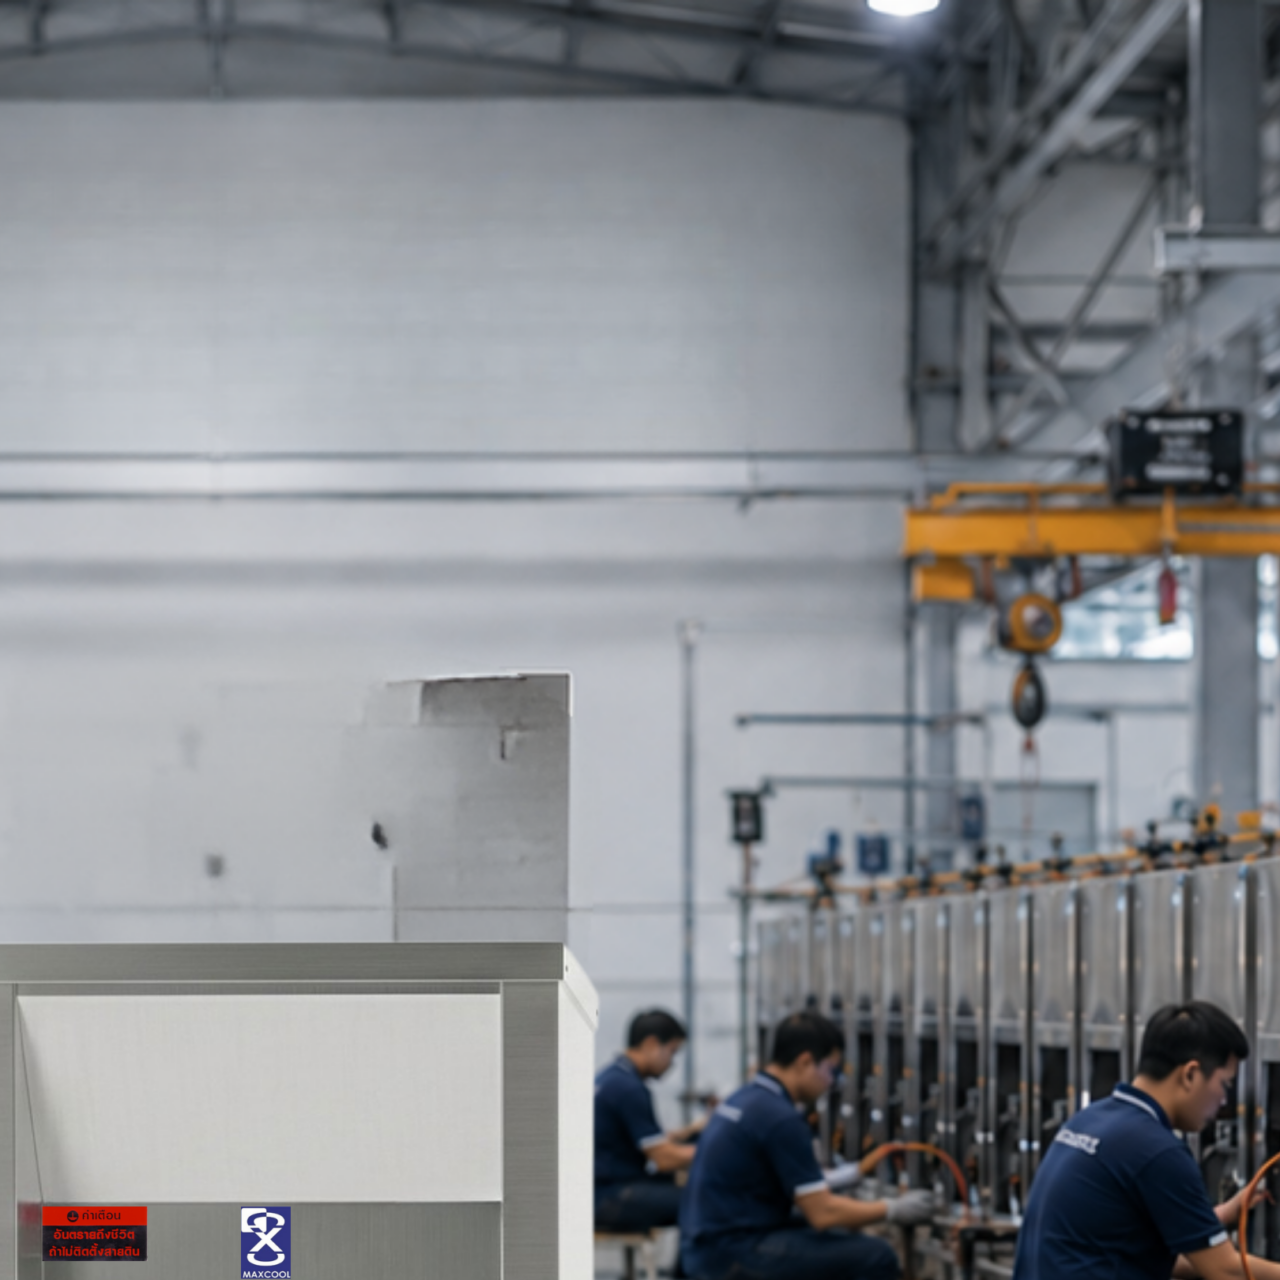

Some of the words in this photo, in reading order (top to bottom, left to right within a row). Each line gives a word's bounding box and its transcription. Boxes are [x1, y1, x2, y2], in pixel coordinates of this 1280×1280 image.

[82, 1209, 121, 1220] คำเตือน
[53, 1228, 135, 1240] อันตรายถึงชีวิต
[49, 1243, 140, 1257] ถ้าไม่ติดตั้งสายดิน
[242, 1270, 291, 1278] MAXCOOL
